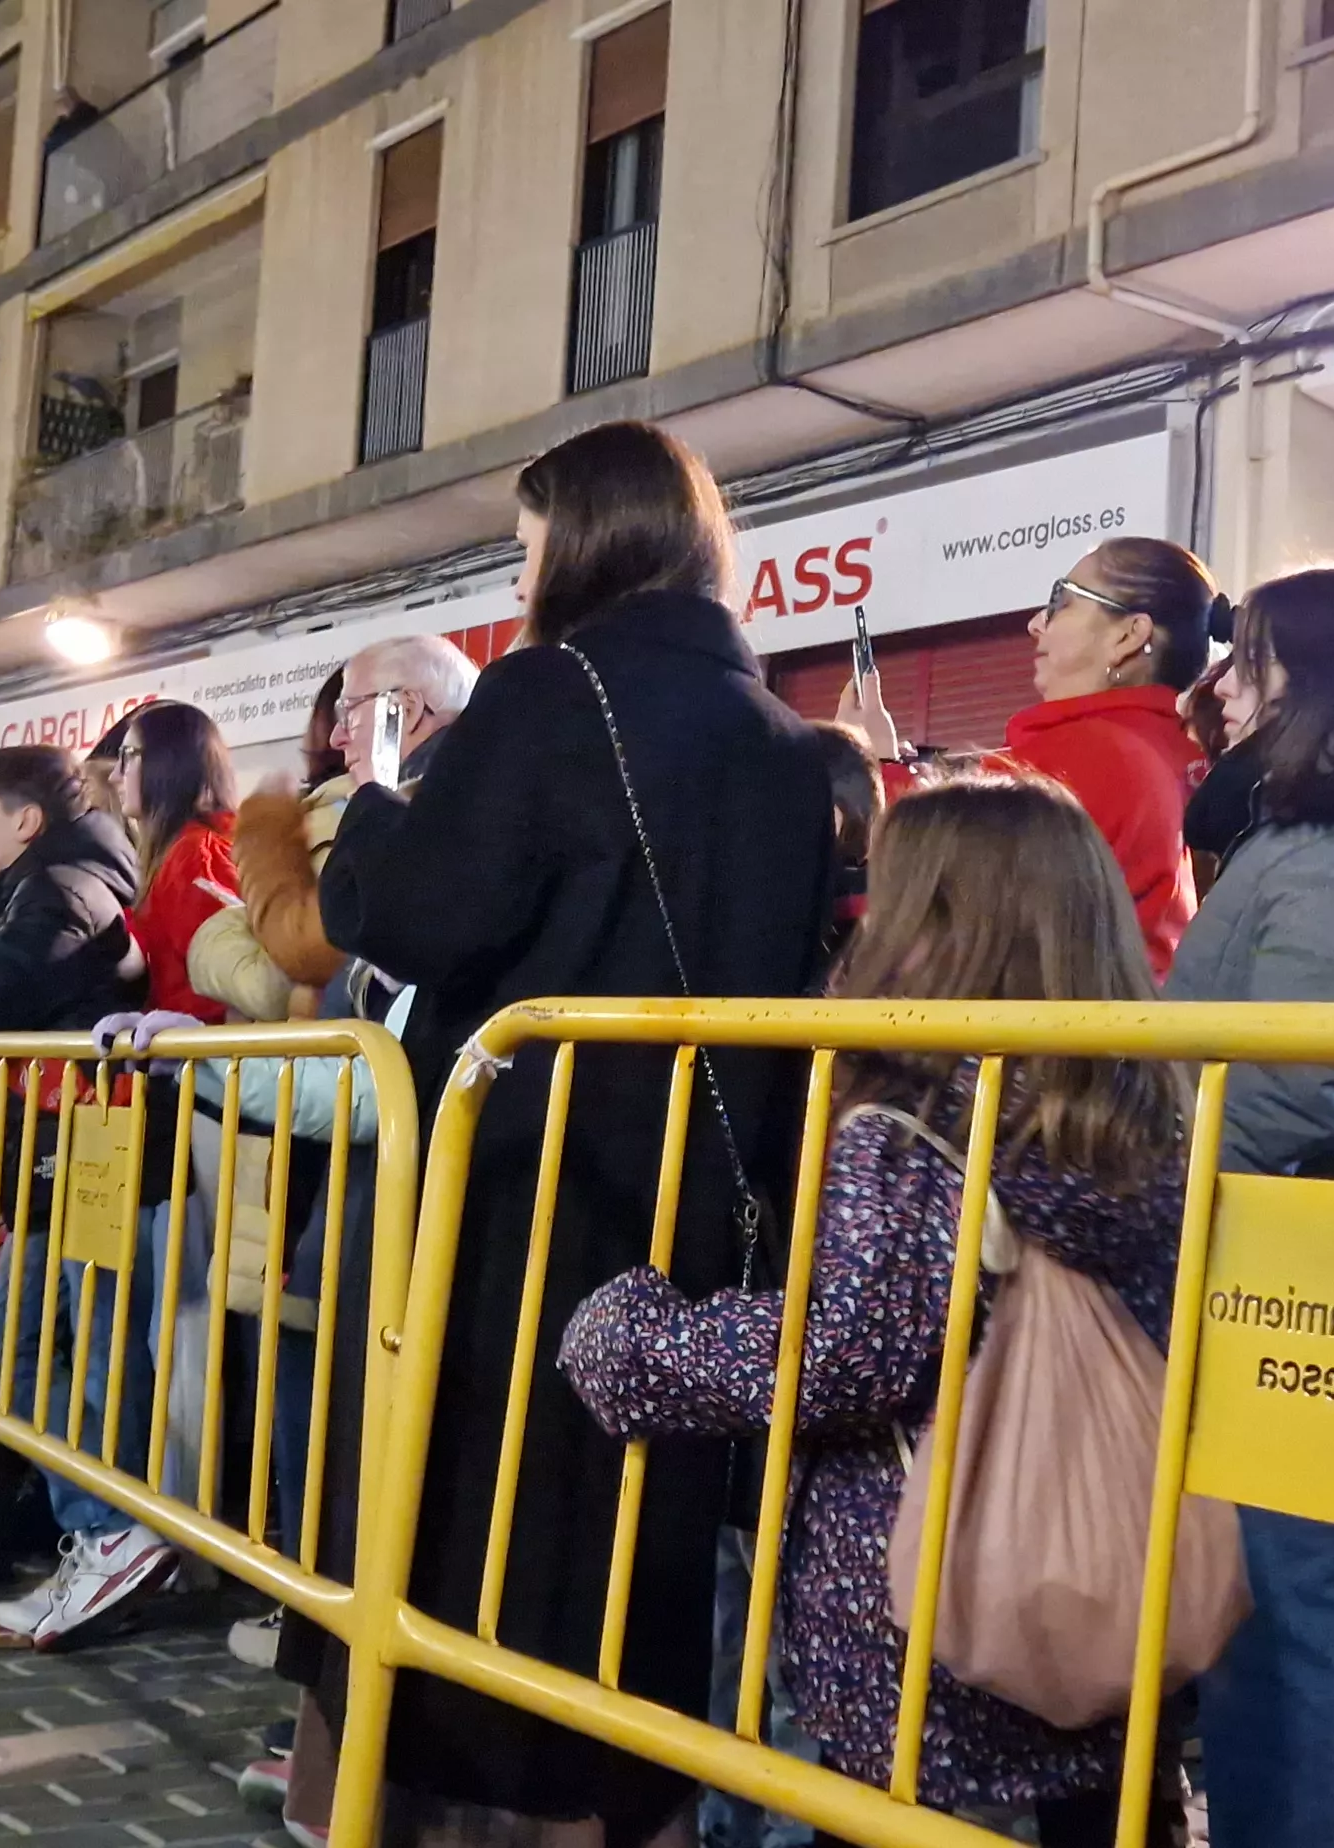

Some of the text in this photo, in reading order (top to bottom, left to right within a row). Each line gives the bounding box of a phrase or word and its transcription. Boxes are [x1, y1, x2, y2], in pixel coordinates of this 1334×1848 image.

[942, 505, 1126, 562] www.carglass.es
[741, 537, 874, 624] ASS
[205, 674, 267, 703] especialista
[269, 672, 283, 688] en
[261, 698, 277, 716] de
[279, 690, 318, 712] vehícu
[0, 693, 158, 751] CARGLA
